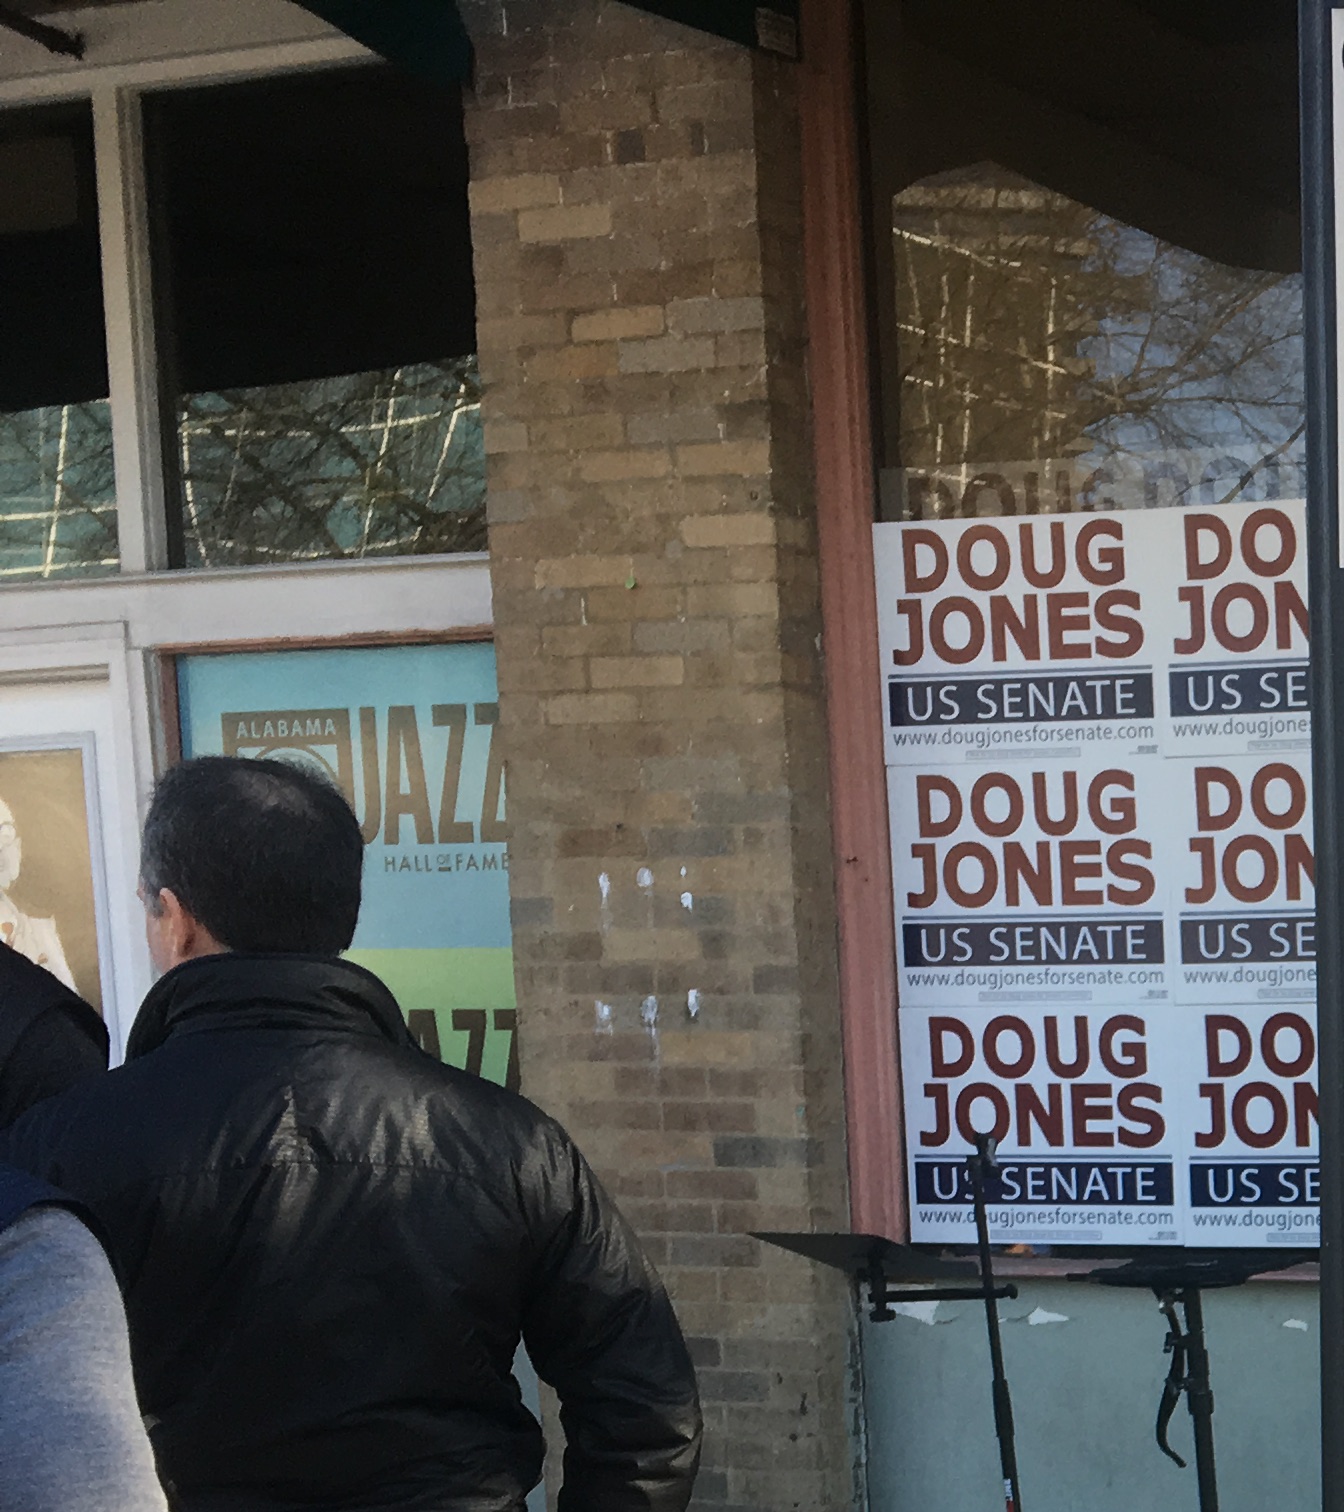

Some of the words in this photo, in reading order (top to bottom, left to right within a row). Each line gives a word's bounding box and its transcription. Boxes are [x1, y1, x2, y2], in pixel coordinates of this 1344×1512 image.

[901, 518, 1126, 594] DOUG
[1183, 508, 1297, 581] DO
[892, 588, 1145, 667] JONES
[1174, 580, 1310, 655] JON
[906, 684, 960, 721] US
[976, 678, 1137, 720] SENATE
[1187, 674, 1242, 712] US
[236, 718, 337, 739] ALABAMA
[892, 722, 1155, 749] www.dougjonesforsenate.com
[916, 769, 1138, 839] DOUG
[1194, 763, 1307, 832] DO
[384, 854, 434, 873] HALL
[437, 853, 452, 872] OF
[456, 852, 510, 872] FAME
[907, 838, 1156, 909] JONES
[1184, 833, 1317, 905] JON
[920, 927, 972, 963] US
[988, 924, 1148, 962] SENATE
[1198, 922, 1253, 960] US
[906, 968, 1165, 990] www.dougjonesforsenate.com
[928, 1013, 1149, 1079] DOUG
[1204, 1012, 1316, 1079] DO
[919, 1081, 1167, 1149] JONES
[1194, 1081, 1320, 1150] JON
[1001, 1166, 1158, 1202] SENATE
[1207, 1167, 1262, 1204] US
